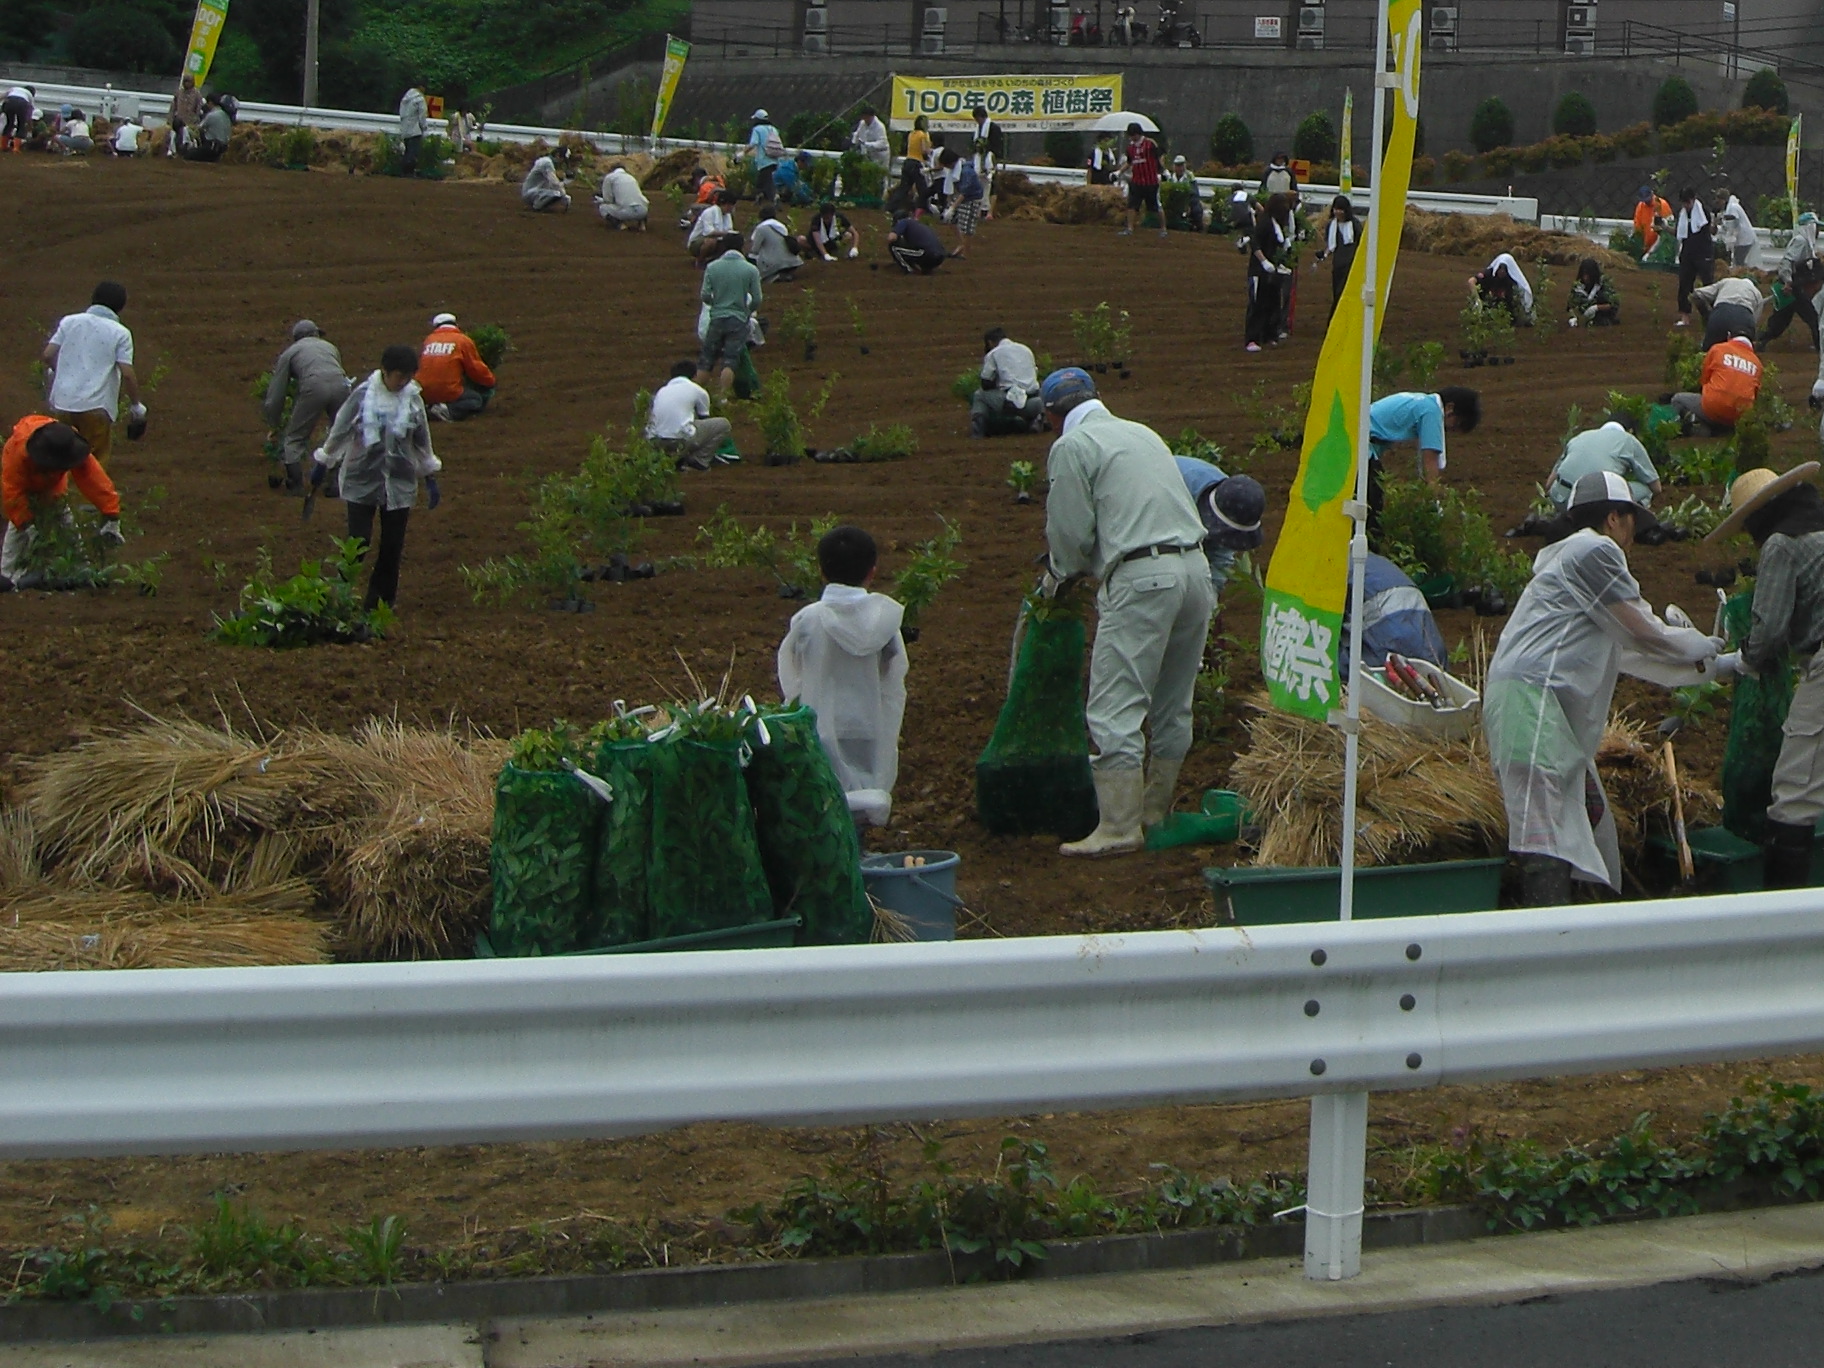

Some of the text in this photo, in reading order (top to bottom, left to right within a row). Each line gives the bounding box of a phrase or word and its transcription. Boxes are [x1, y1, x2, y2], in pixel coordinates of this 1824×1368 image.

[904, 87, 1113, 115] 100年の森 植樹祭
[423, 342, 456, 355] STAFF
[1723, 353, 1758, 376] STAFF
